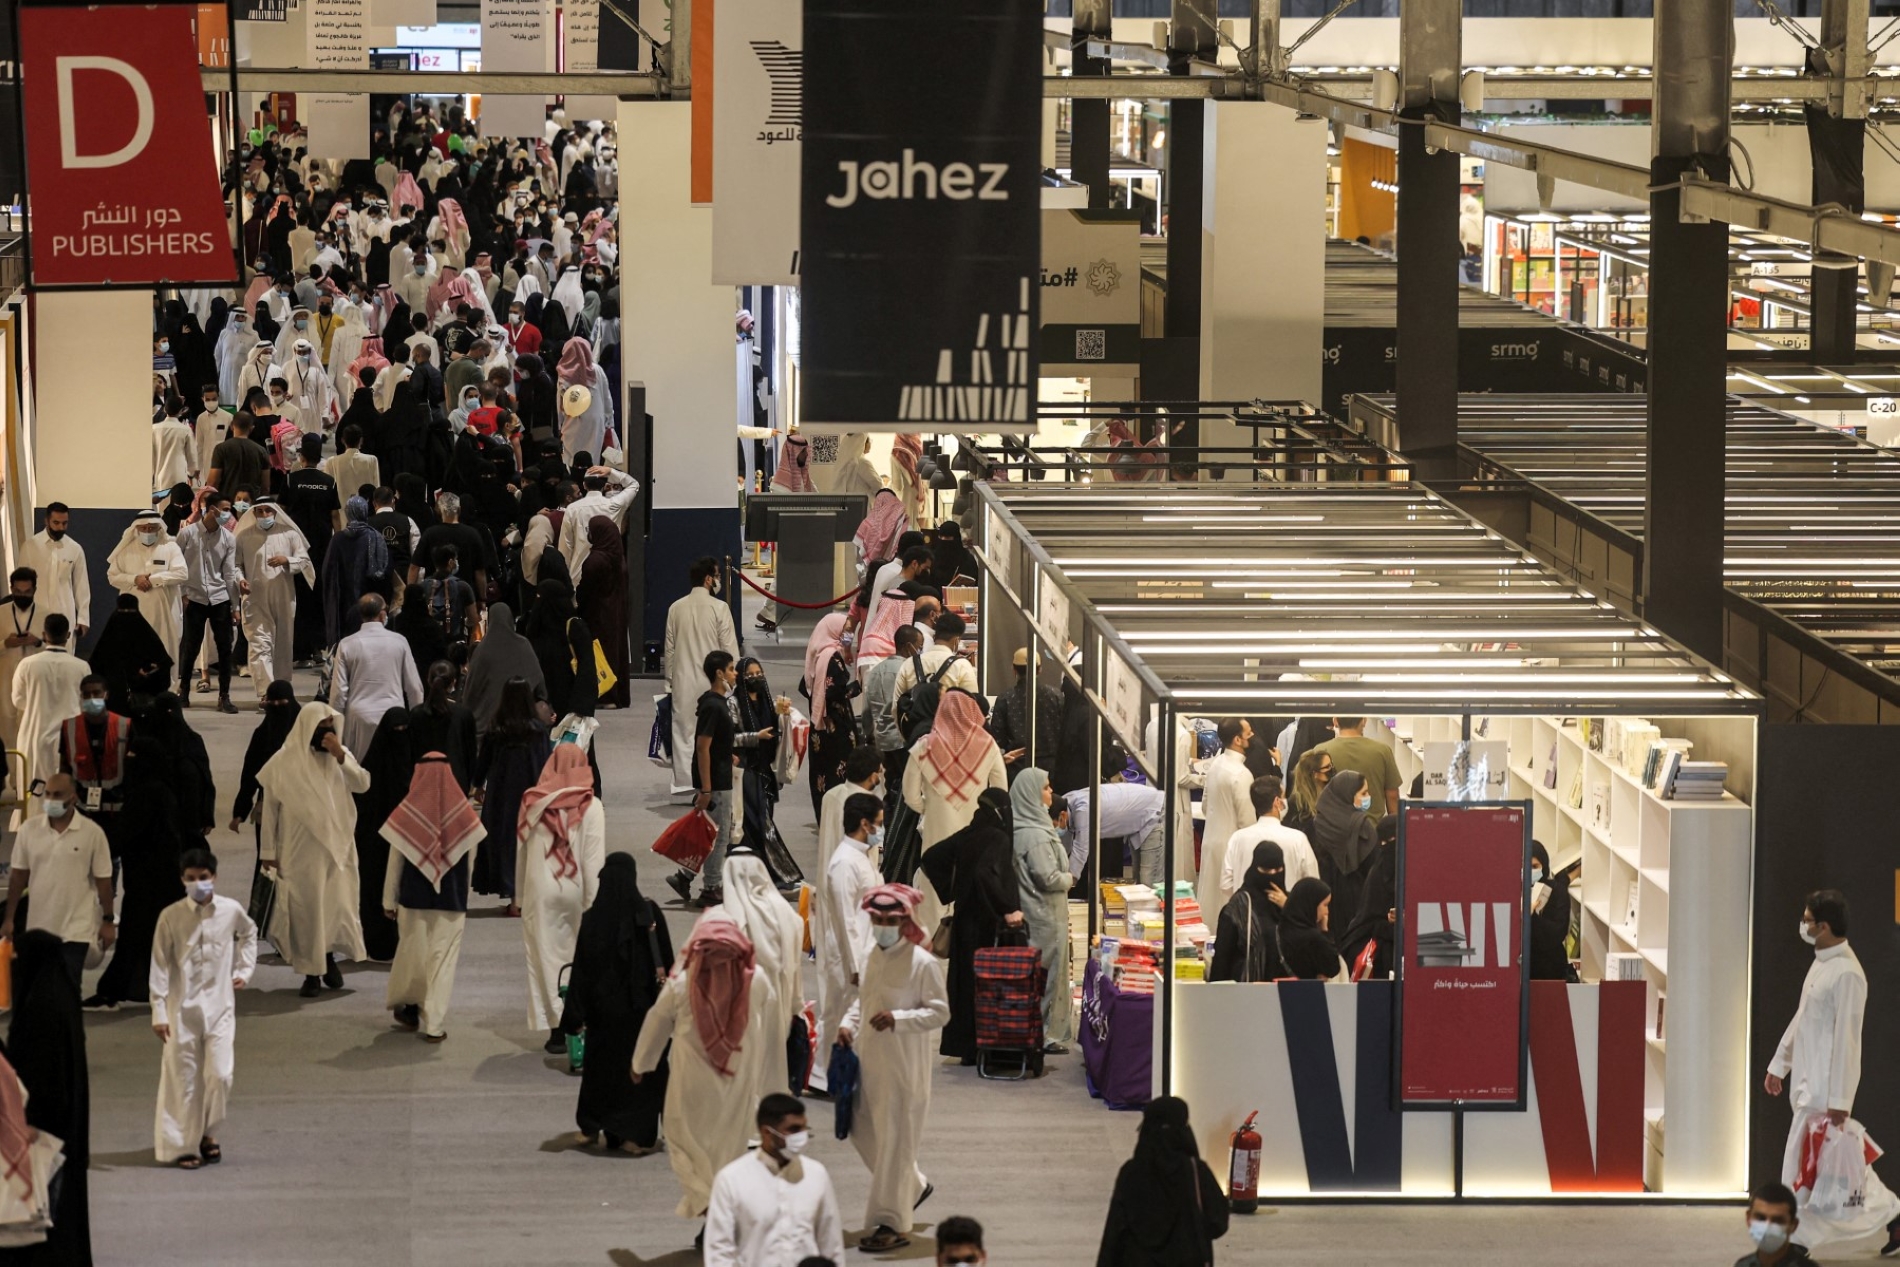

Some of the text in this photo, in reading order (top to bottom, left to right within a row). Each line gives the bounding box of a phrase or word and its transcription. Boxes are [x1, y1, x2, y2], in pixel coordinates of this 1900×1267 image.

[56, 56, 155, 169] D
[756, 127, 794, 145] للعود
[81, 202, 183, 231] دور النشر
[52, 232, 215, 257] PUBLISHERS
[1491, 340, 1540, 361] srmg
[1870, 403, 1897, 414] C-20
